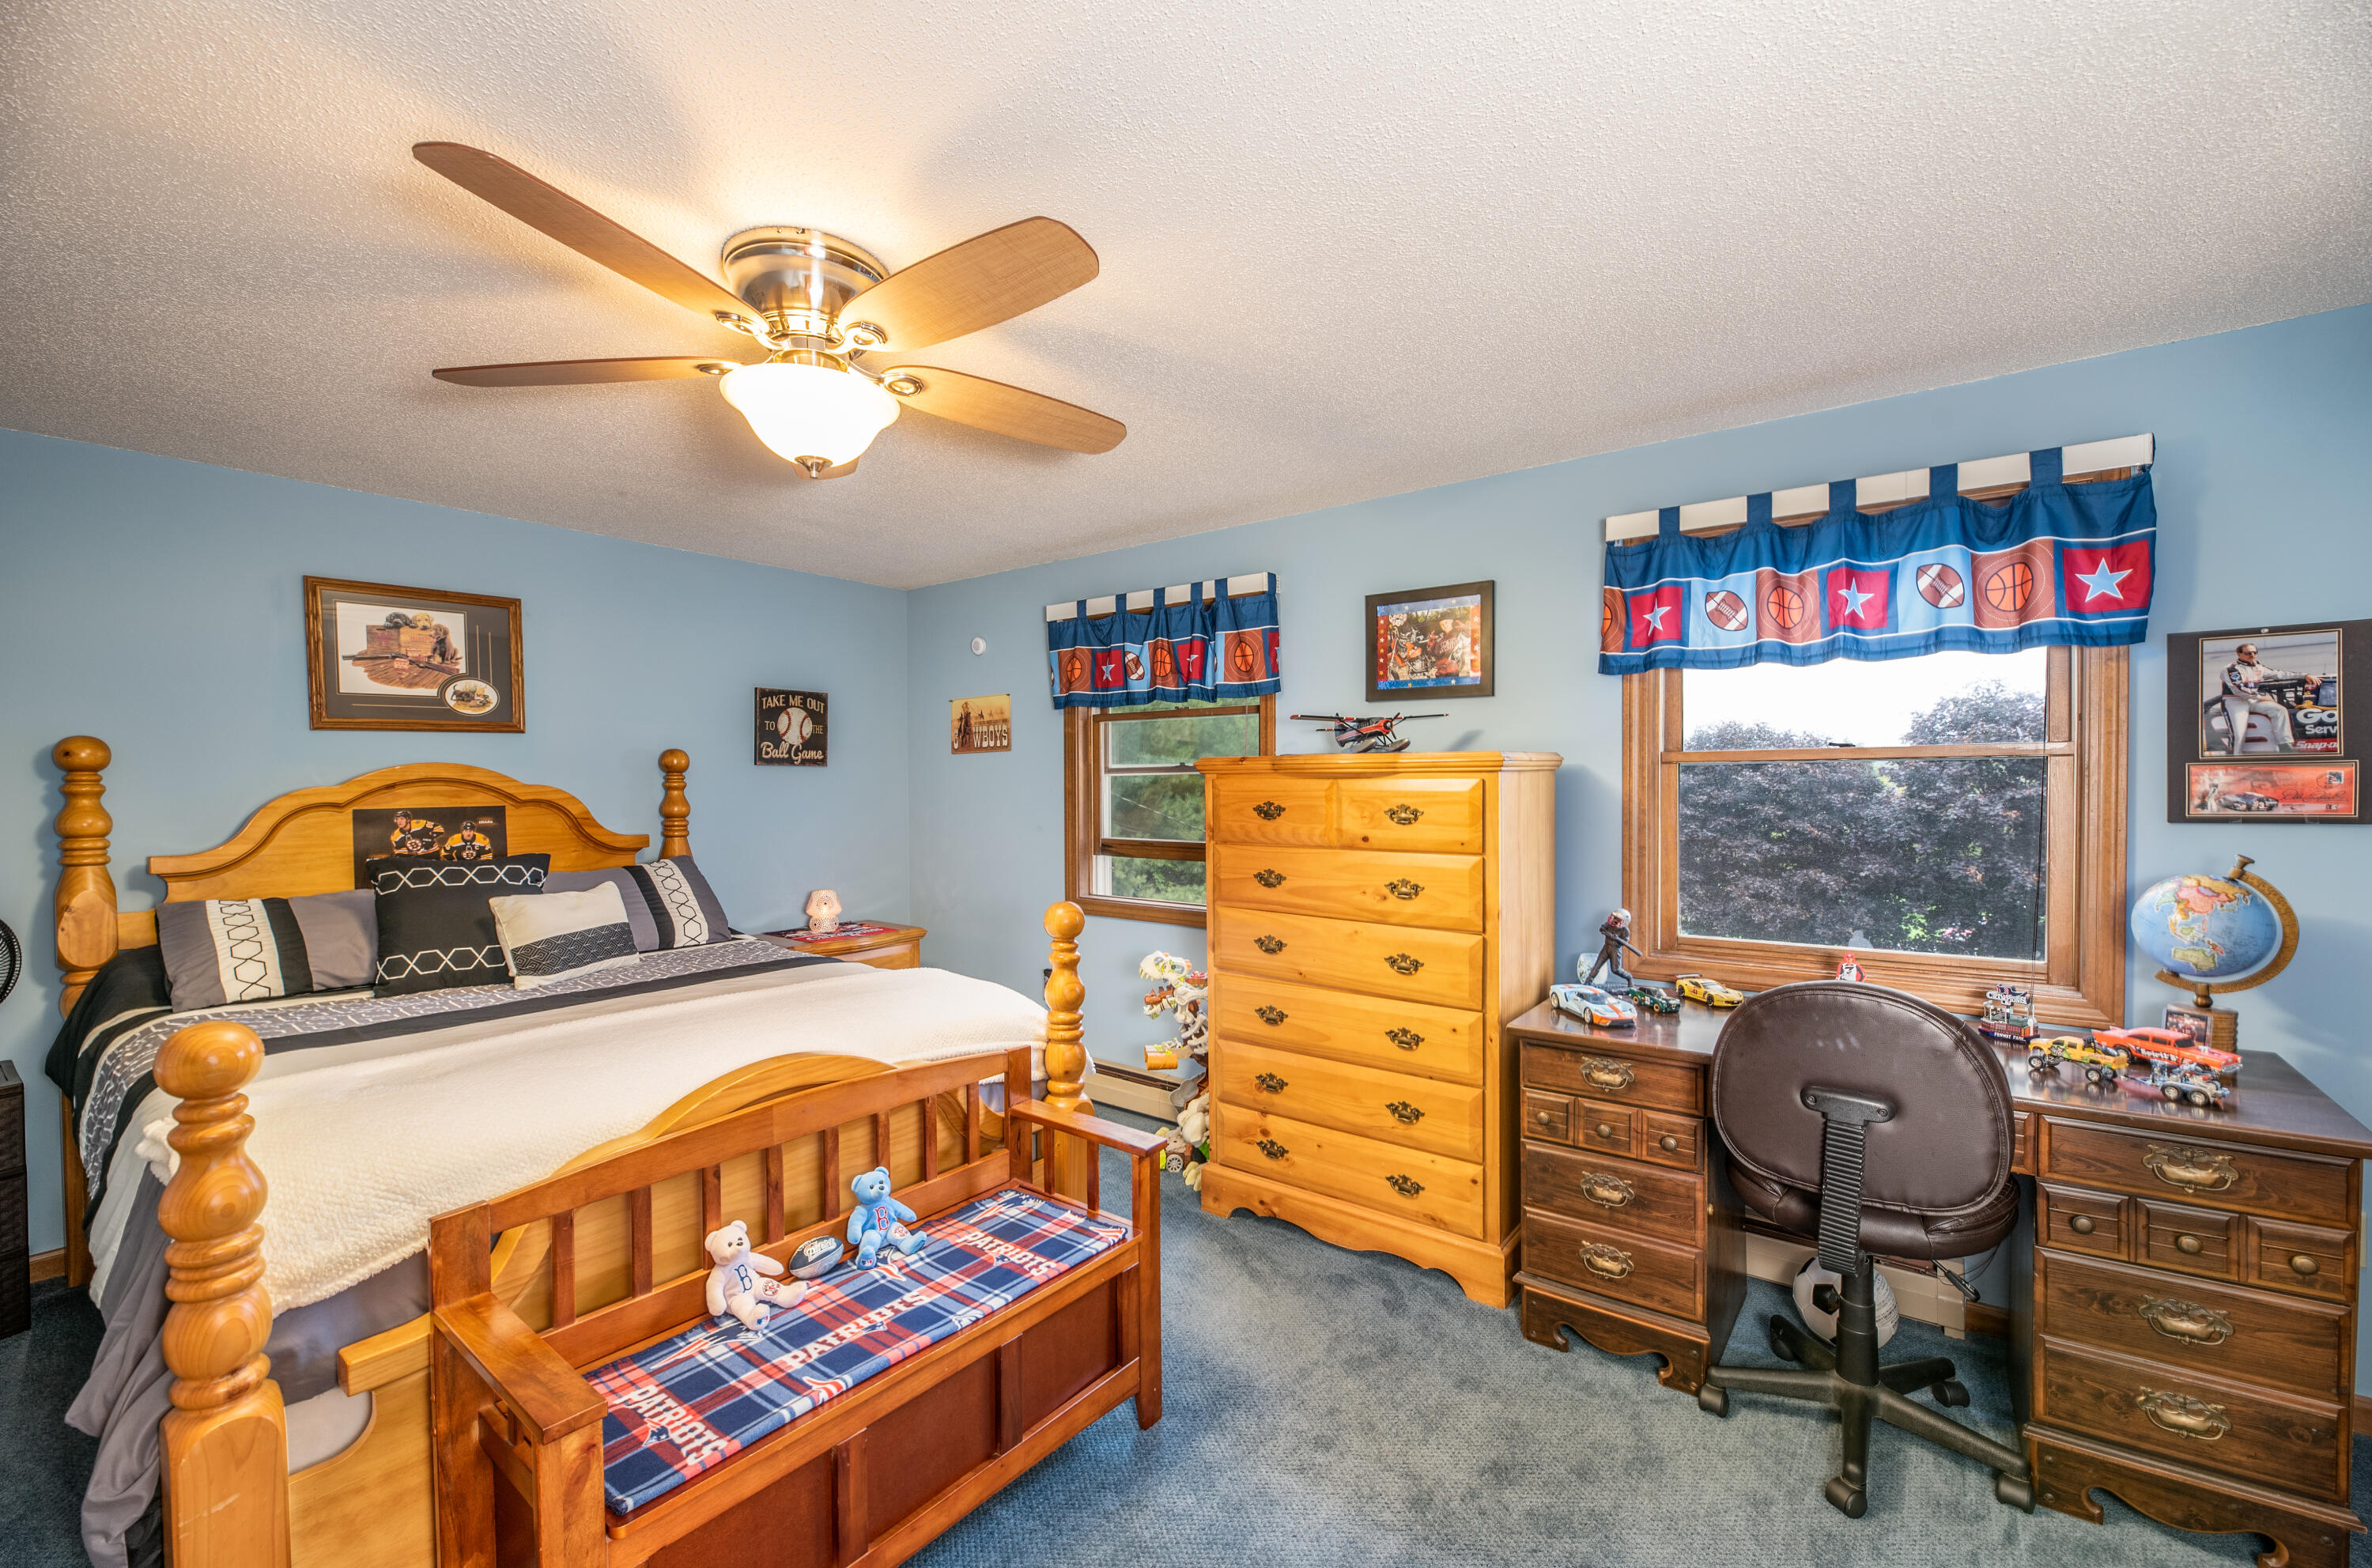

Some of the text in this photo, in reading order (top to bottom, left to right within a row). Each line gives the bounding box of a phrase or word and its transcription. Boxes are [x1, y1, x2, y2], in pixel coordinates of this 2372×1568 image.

[761, 694, 825, 714] TAKE ME OUT
[765, 720, 824, 735] TO THE
[2305, 724, 2338, 735] Serv
[761, 741, 825, 765] Ball Game
[873, 1206, 890, 1232] B
[956, 1231, 1057, 1276] PATRIOTS
[734, 1264, 752, 1293] B
[788, 1290, 931, 1370] PATRIOTS
[613, 1385, 729, 1466] PATRIOTS
